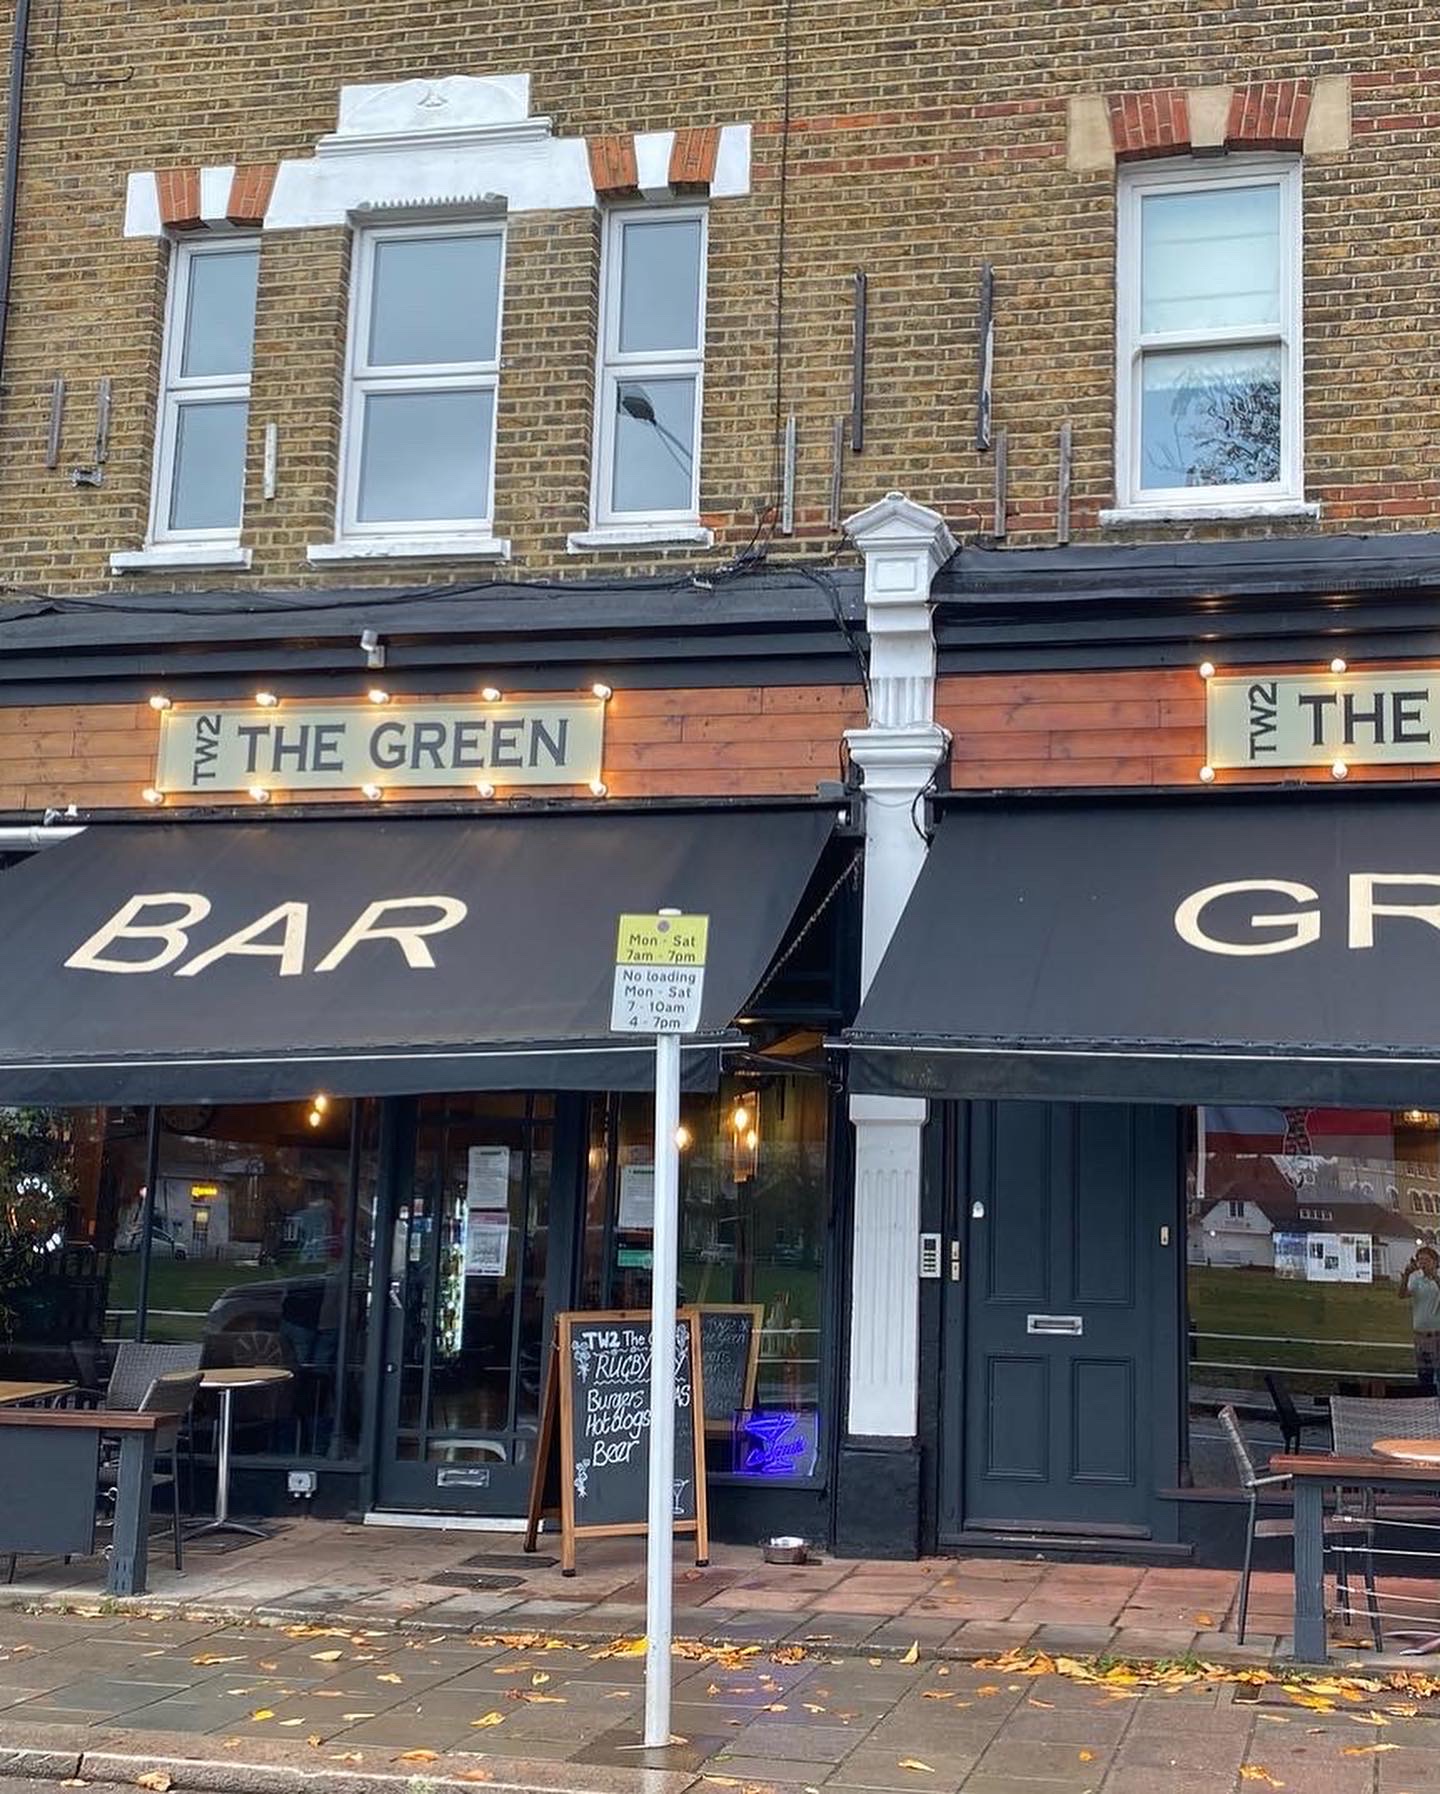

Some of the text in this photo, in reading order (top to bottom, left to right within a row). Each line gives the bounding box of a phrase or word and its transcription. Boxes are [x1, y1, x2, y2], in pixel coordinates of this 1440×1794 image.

[1248, 682, 1278, 760] TW2
[1298, 688, 1431, 746] THE
[192, 714, 221, 786] TW2
[237, 718, 569, 773] THE GREEN
[63, 892, 468, 976] BAR
[629, 934, 658, 946] Mon
[673, 934, 695, 947] Sat
[627, 949, 653, 960] 7am
[668, 950, 696, 963] 7pm
[623, 970, 696, 985] No loading
[624, 985, 653, 997] Mon
[668, 986, 691, 998] Sat
[628, 1001, 635, 1012] 7
[650, 1002, 685, 1013] 10am
[629, 1016, 639, 1028] 4
[653, 1016, 681, 1029] 7pm
[582, 1331, 621, 1350] TW2
[622, 1330, 646, 1347] The
[595, 1353, 653, 1380] RUGBY
[587, 1389, 645, 1412] Burgers
[592, 1440, 640, 1466] Beer
